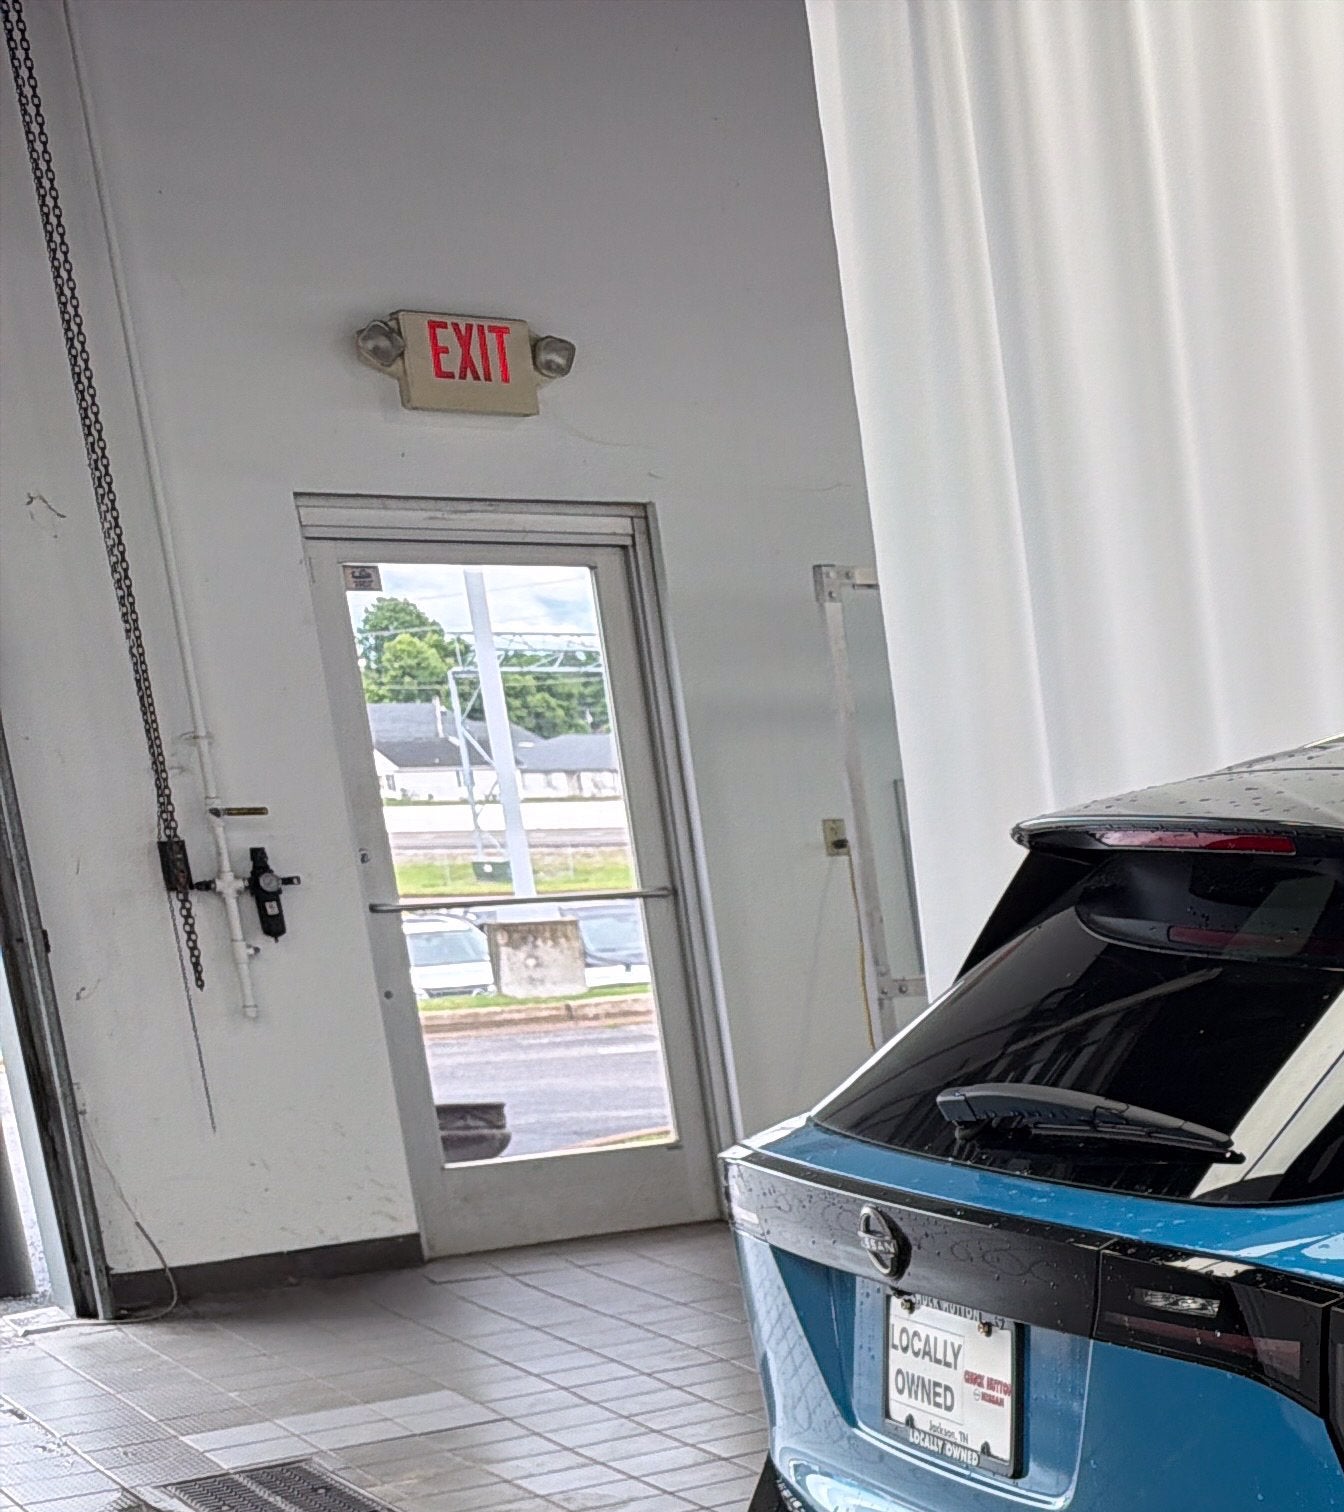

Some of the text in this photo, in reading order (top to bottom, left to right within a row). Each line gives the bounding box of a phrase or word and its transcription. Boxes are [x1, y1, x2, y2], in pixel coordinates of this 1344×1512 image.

[426, 319, 511, 384] EXIT
[891, 1323, 963, 1371] LOCALLY
[895, 1367, 955, 1413] OWNED
[909, 1427, 979, 1466] LOCALLY OWNED
[959, 1430, 969, 1445] TN
